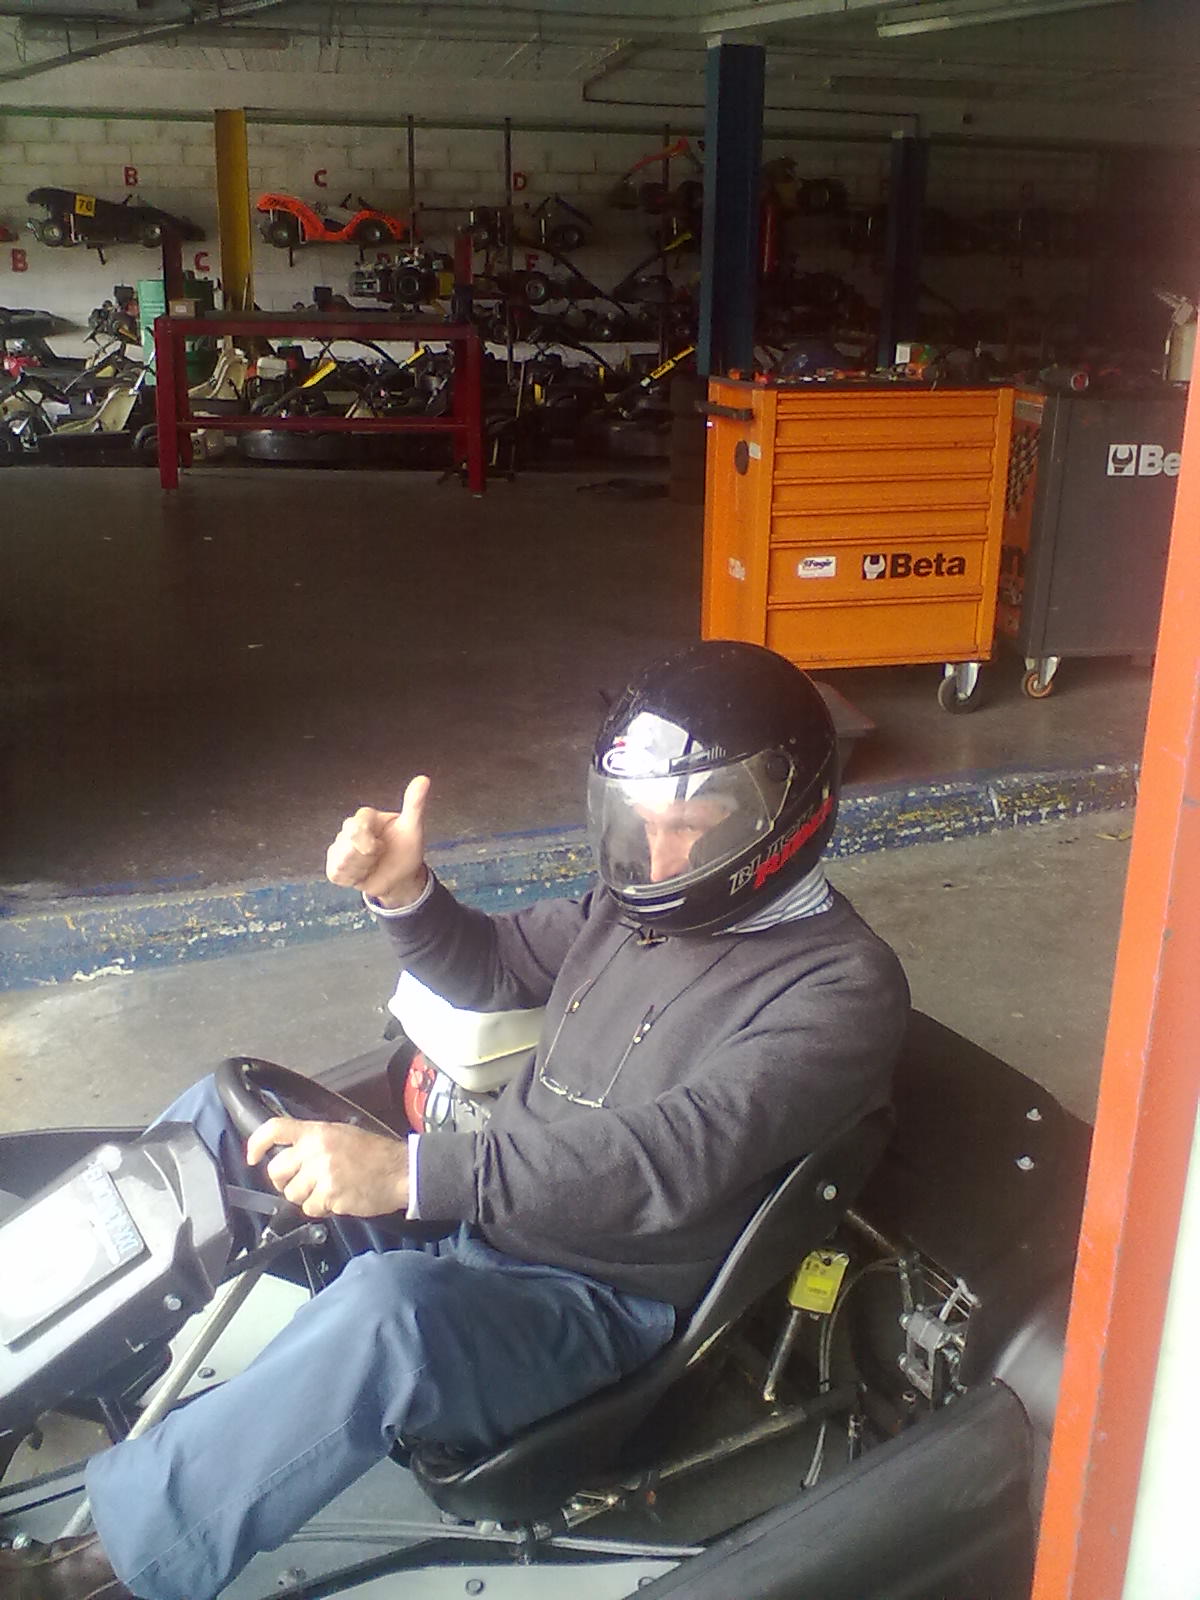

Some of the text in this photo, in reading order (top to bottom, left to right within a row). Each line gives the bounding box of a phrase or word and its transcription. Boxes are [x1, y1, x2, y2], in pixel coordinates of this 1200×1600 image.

[124, 166, 138, 186] B
[313, 169, 327, 187] C
[513, 172, 526, 191] D
[11, 248, 28, 272] B
[194, 252, 210, 271] C
[890, 552, 966, 578] Beta
